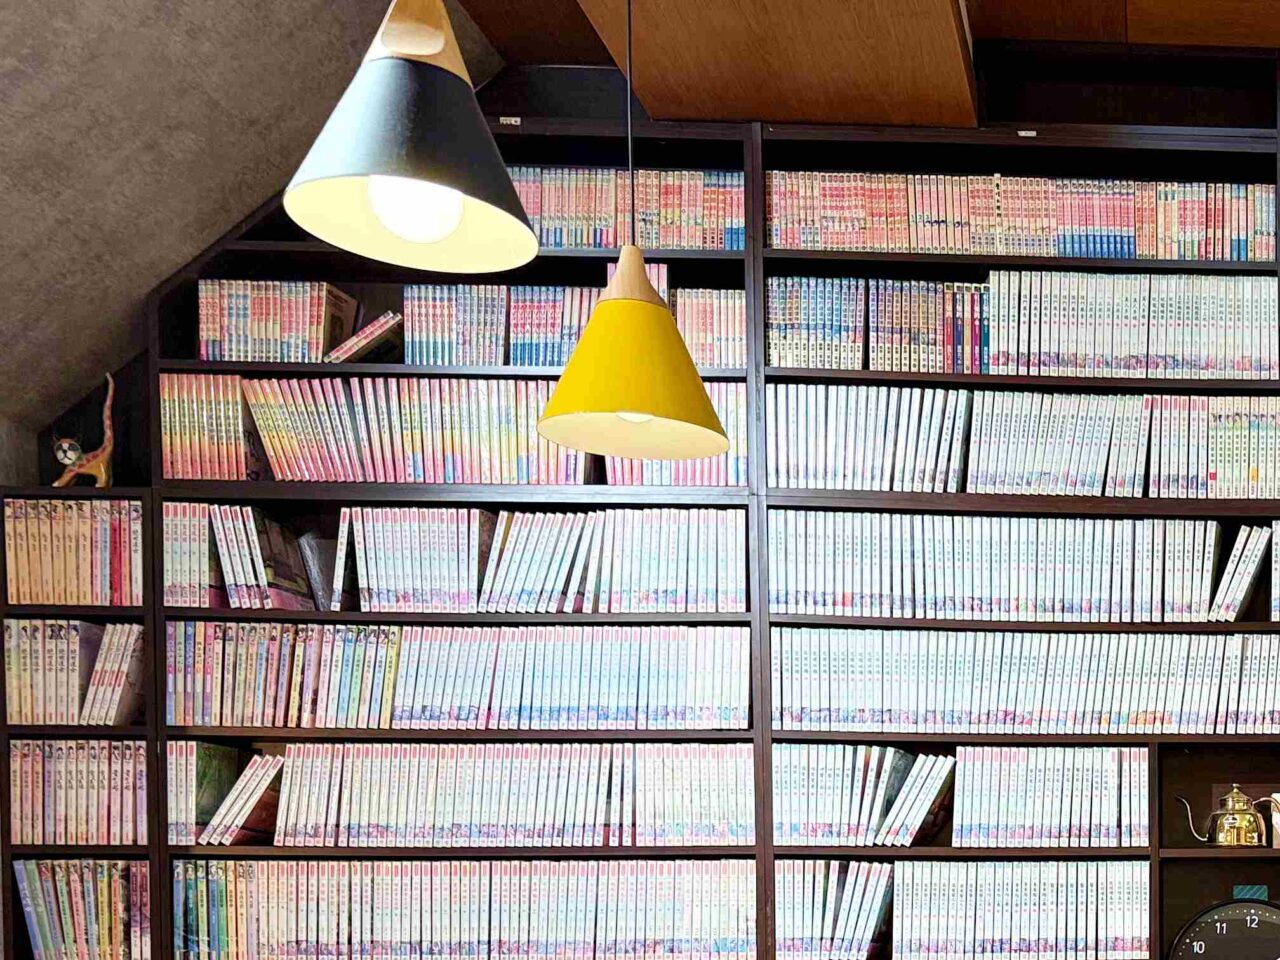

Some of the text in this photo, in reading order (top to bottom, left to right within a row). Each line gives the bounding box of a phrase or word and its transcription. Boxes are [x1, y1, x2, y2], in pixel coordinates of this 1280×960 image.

[1245, 916, 1258, 928] 12
[1215, 923, 1227, 934] 11
[1192, 941, 1205, 954] 10
